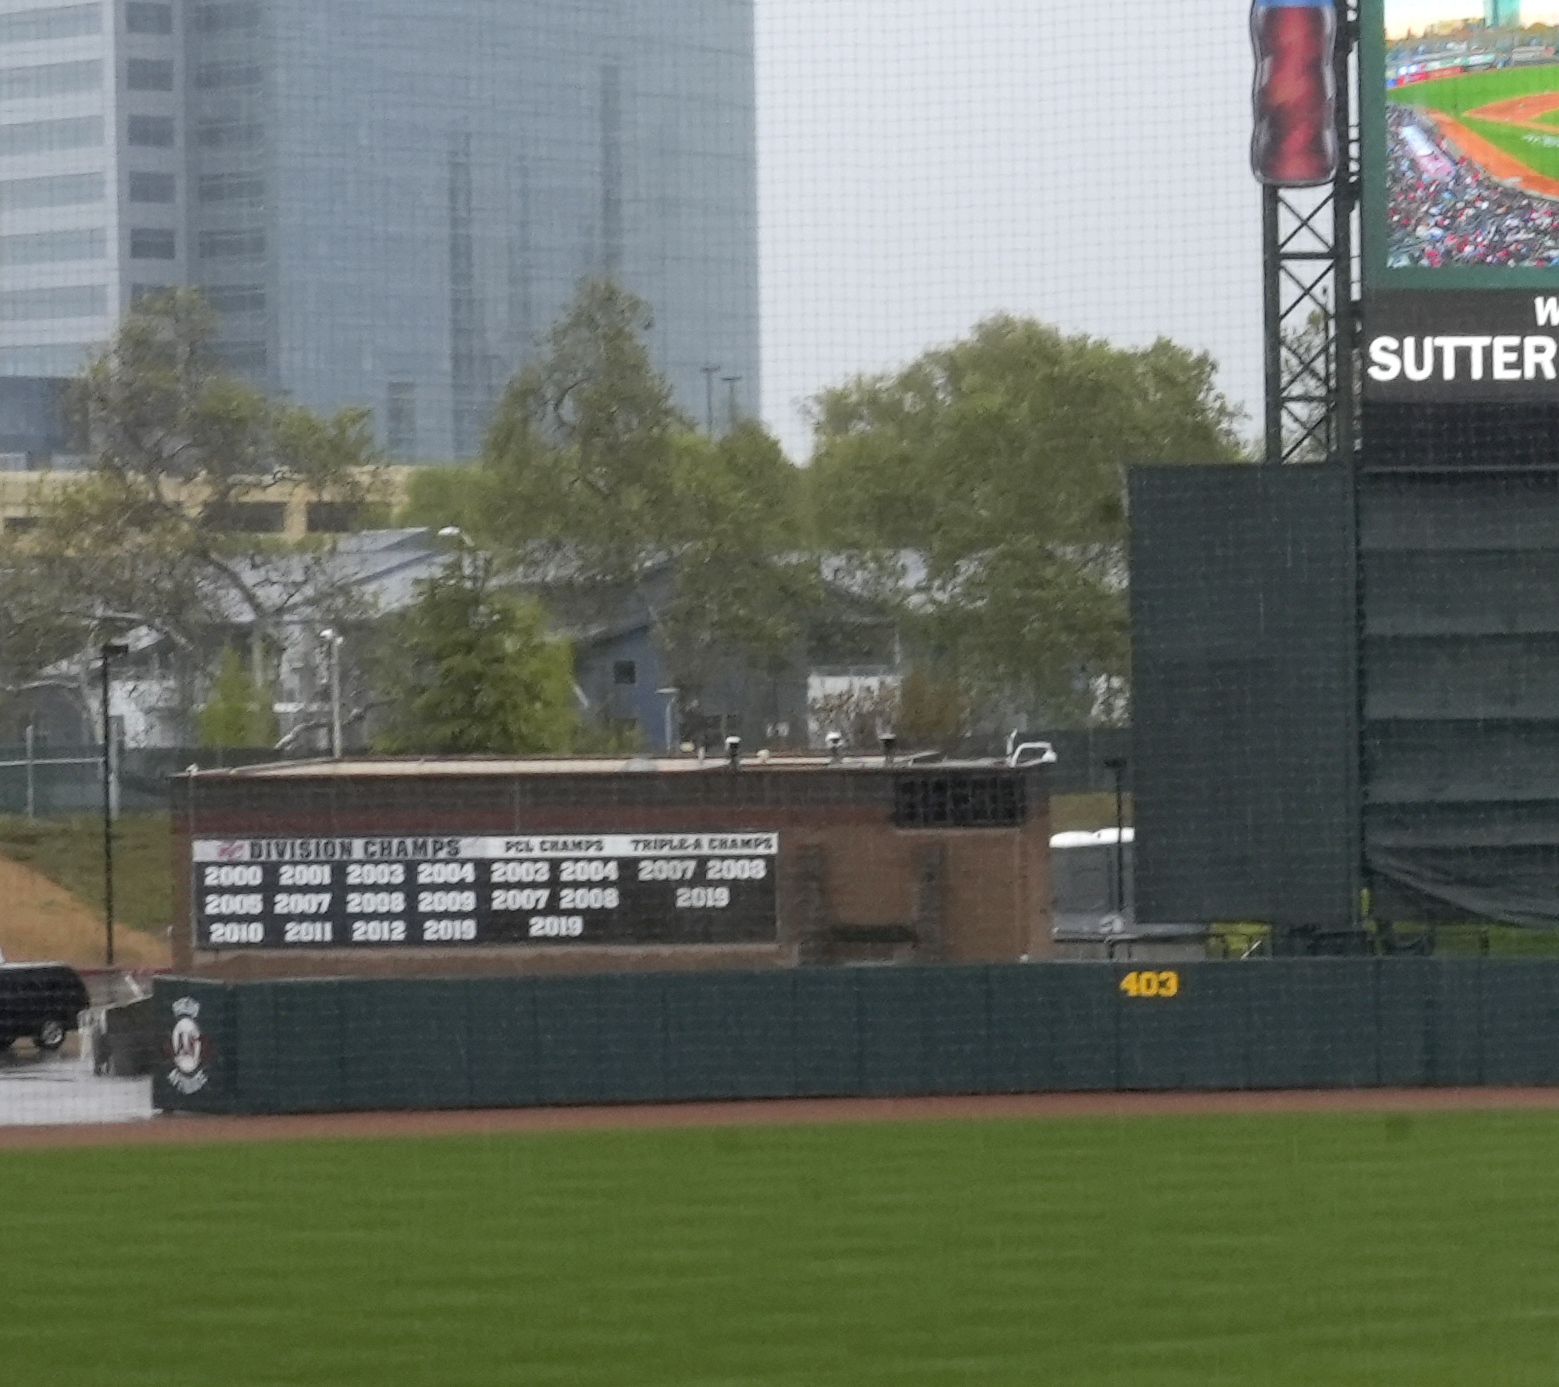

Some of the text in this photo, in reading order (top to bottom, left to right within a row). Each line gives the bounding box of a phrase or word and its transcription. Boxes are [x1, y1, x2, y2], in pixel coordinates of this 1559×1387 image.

[1367, 335, 1557, 381] SUTTER
[249, 840, 353, 860] DIVISION
[364, 839, 460, 858] CHAMPS
[540, 839, 604, 852] CHAMPS
[708, 837, 774, 850] CHAMPS
[204, 863, 476, 886] 2000 2001 2003 2004
[559, 860, 619, 881] 2004
[638, 860, 697, 881] 2007
[273, 893, 332, 914] 2007
[491, 889, 551, 910] 2007
[675, 887, 730, 908] 2019
[209, 919, 477, 943] 2010 2011 2012 2019
[529, 916, 583, 937] 2019
[1120, 971, 1178, 998] 403
